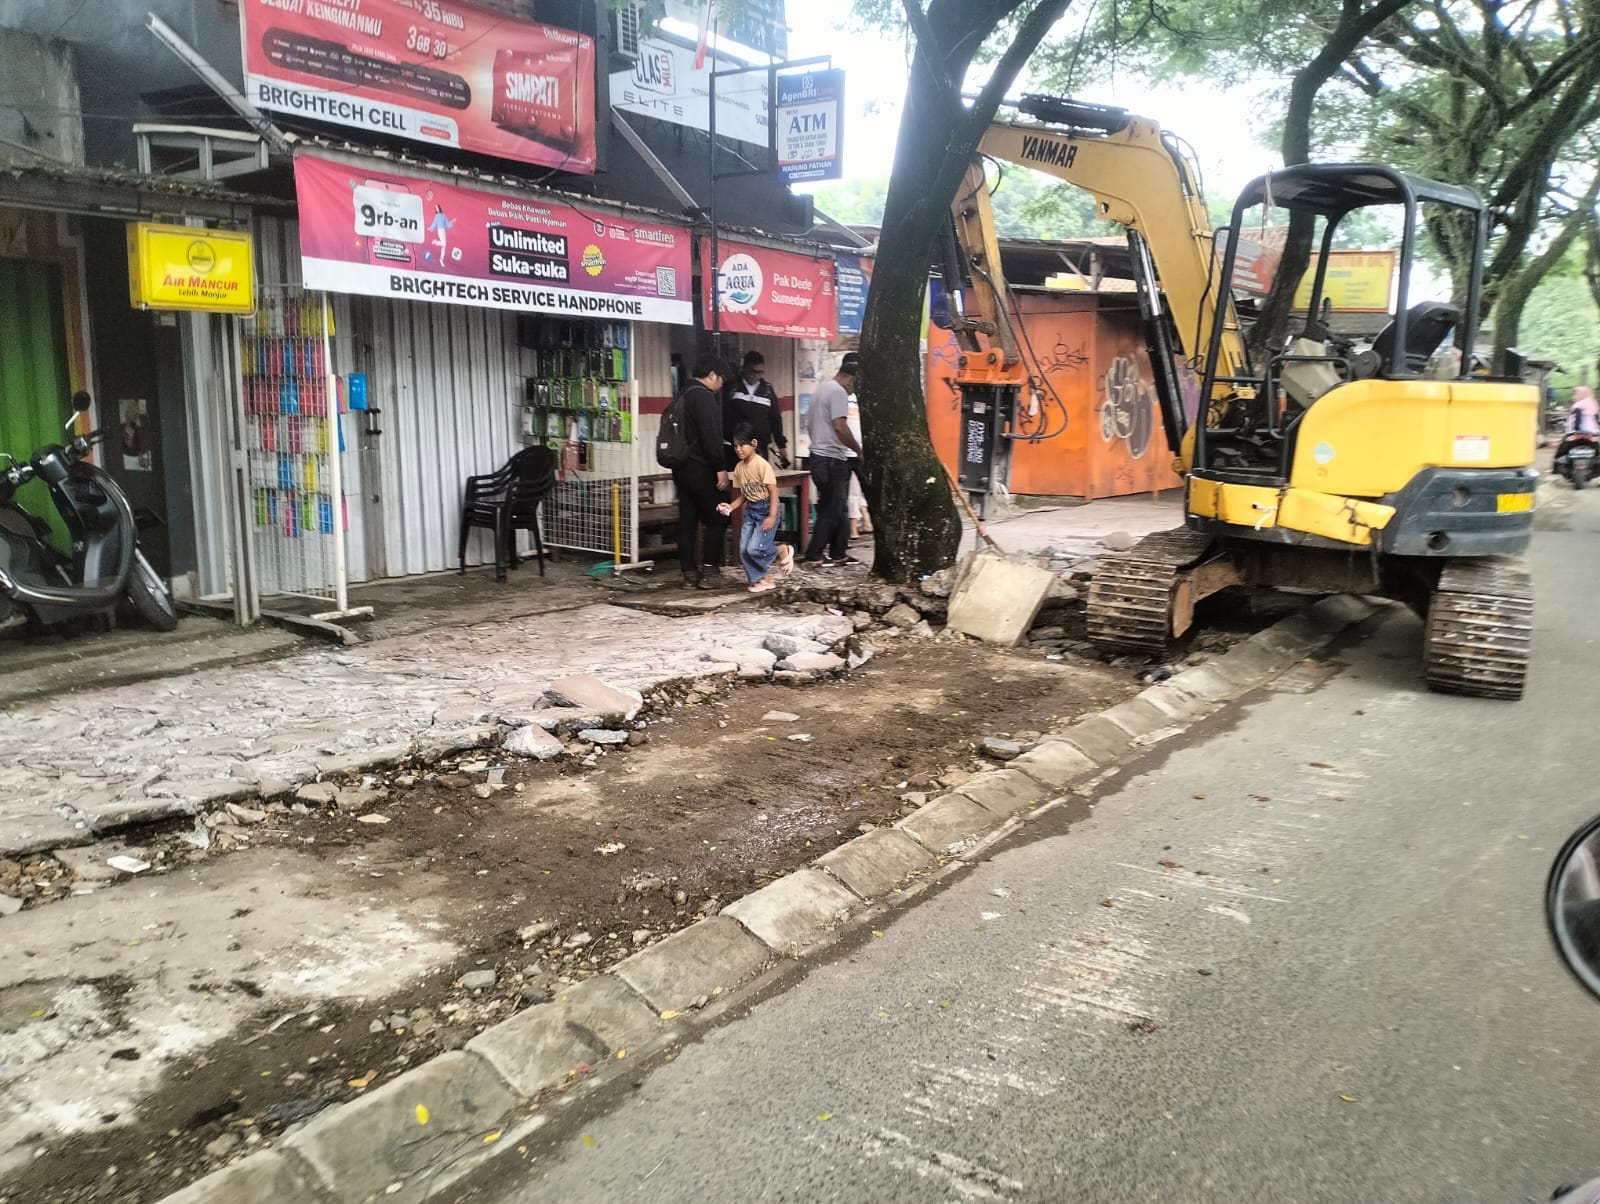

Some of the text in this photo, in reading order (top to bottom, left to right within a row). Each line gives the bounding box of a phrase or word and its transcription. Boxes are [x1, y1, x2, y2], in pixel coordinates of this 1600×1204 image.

[423, 0, 441, 22] 35
[441, 10, 464, 29] RIBU
[406, 26, 417, 49] 3
[416, 34, 431, 53] GB
[433, 39, 447, 58] 30
[661, 54, 673, 88] MILD
[505, 71, 559, 108] SIMPATI
[258, 84, 407, 131] BRIGHTECH CELL
[623, 90, 684, 117] ELITE
[788, 112, 827, 134] ATM
[1020, 135, 1078, 169] YANMAR
[360, 204, 418, 231] 9rb-an
[487, 208, 508, 218] Bebas
[501, 200, 522, 212] Bebas
[492, 228, 565, 256] Unlimited
[634, 229, 675, 244] smartfren
[492, 254, 567, 280] Suka-suka
[731, 263, 749, 272] ADA
[390, 275, 643, 315] BRIGHTECH SERVICE HANDPHONE
[725, 275, 755, 291] AQUA
[773, 273, 790, 286] Pak
[791, 275, 812, 290] Dede
